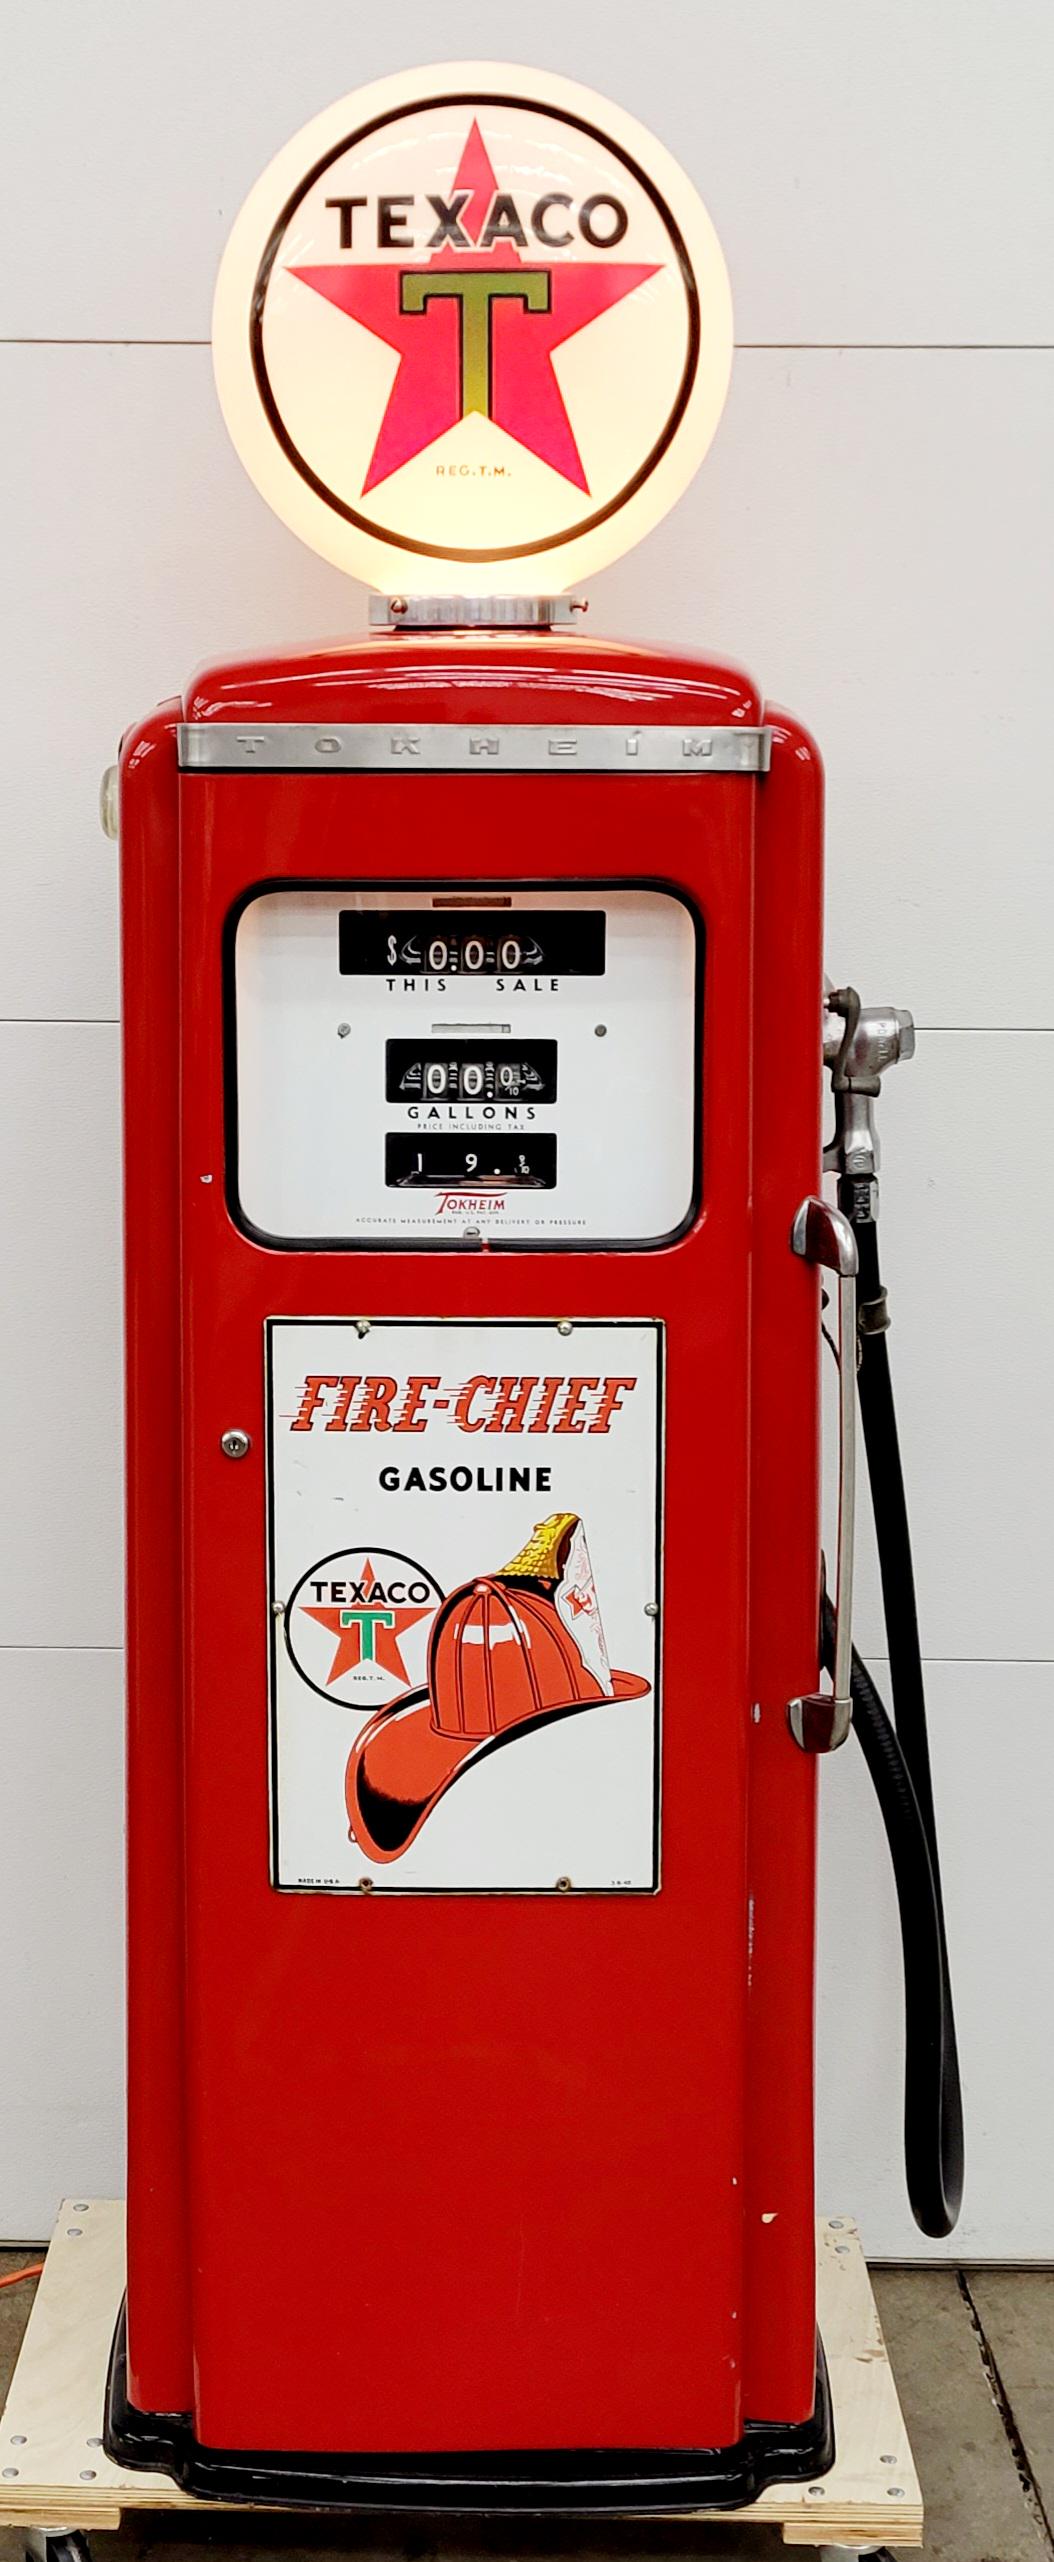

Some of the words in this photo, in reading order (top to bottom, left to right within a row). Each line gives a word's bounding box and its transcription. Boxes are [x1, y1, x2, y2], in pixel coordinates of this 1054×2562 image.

[325, 193, 629, 250] TEXACO
[399, 269, 552, 420] T
[236, 736, 713, 757] TOKHEIM
[386, 979, 447, 992] THIS
[496, 979, 559, 992] SALE
[407, 1106, 536, 1120] GALLONS
[434, 1192, 508, 1216] TOKHEIM
[286, 1375, 638, 1434] FIRE-CHIEF
[379, 1466, 552, 1492] GASOLINE
[309, 1580, 432, 1604] TEXACO
[339, 1610, 396, 1661] T
